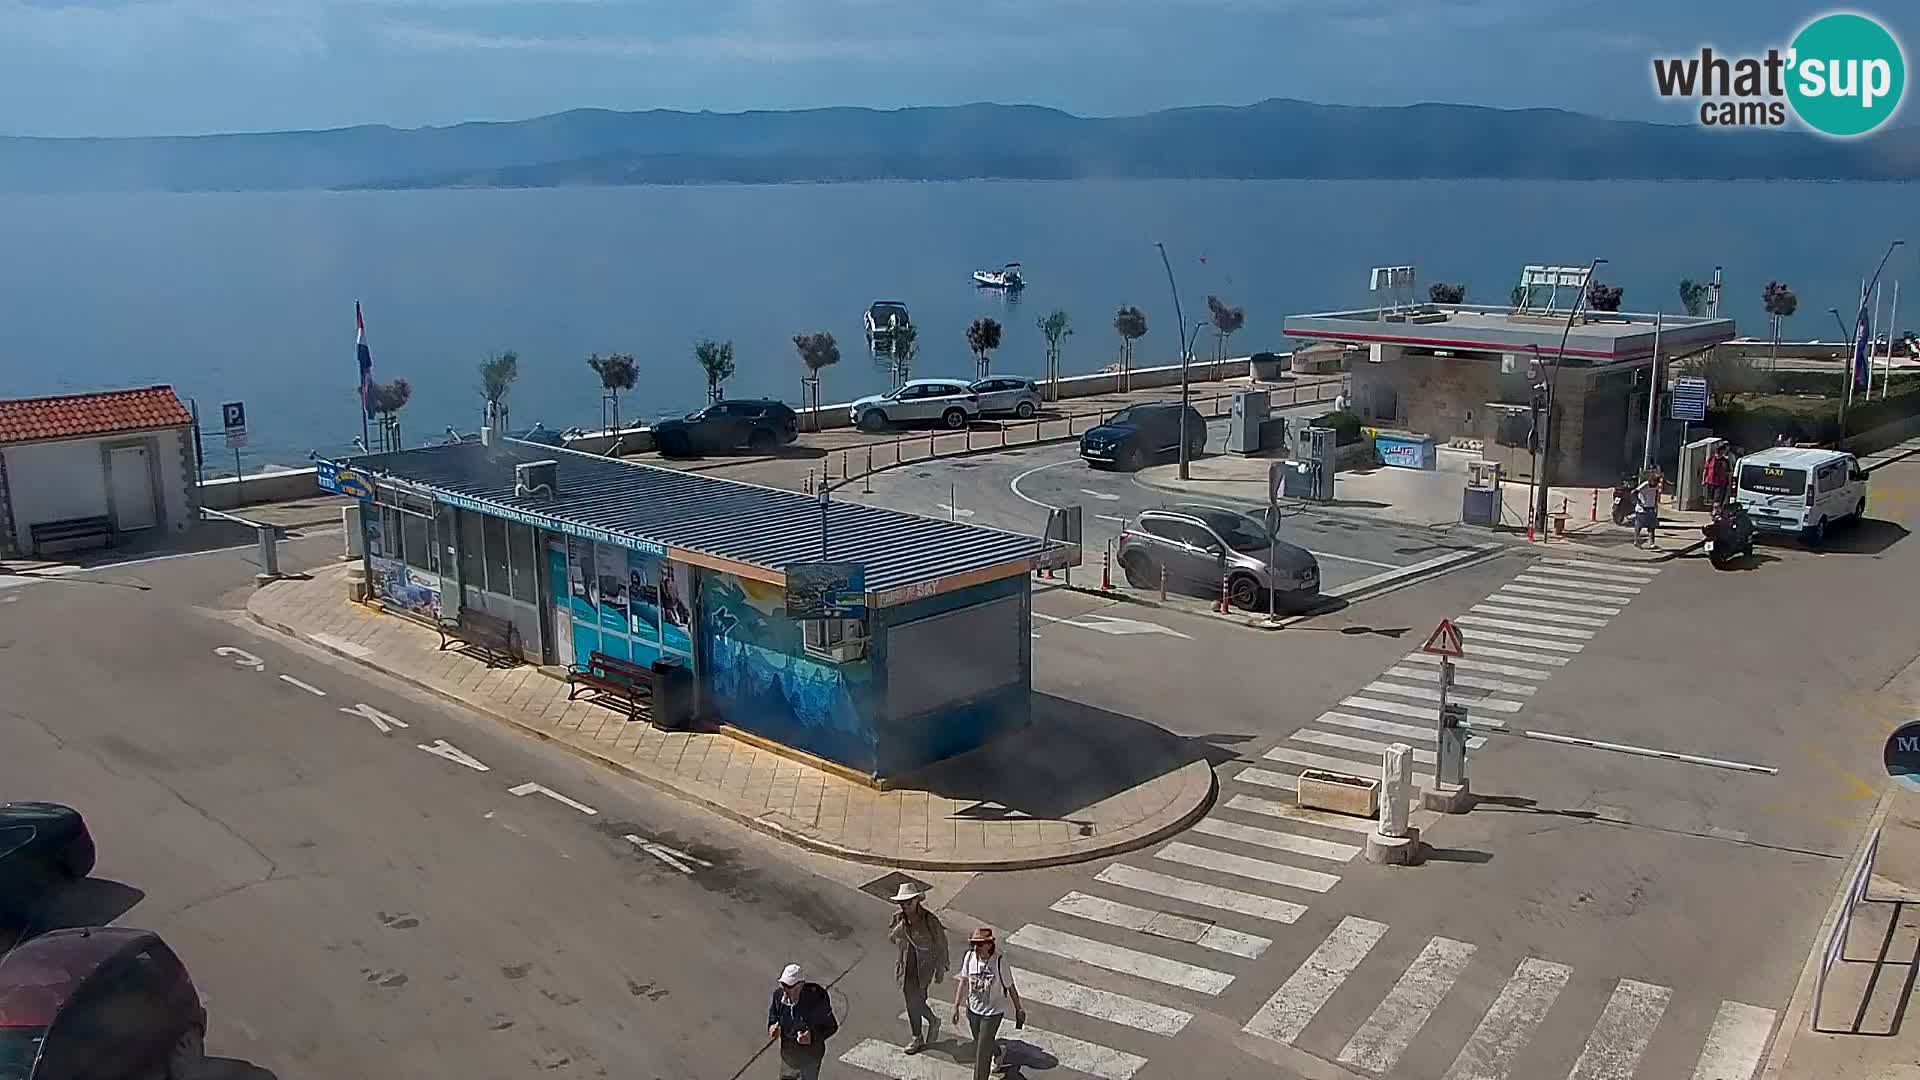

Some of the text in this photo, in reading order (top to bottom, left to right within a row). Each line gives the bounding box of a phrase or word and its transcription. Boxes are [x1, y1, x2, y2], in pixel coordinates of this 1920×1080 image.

[228, 407, 239, 424] P
[1764, 468, 1784, 476] TAXI
[521, 514, 552, 527] POSTAJA
[562, 522, 575, 534] BUS
[577, 526, 609, 542] STATION
[611, 533, 636, 549] TICKET
[637, 541, 663, 554] OFFICE
